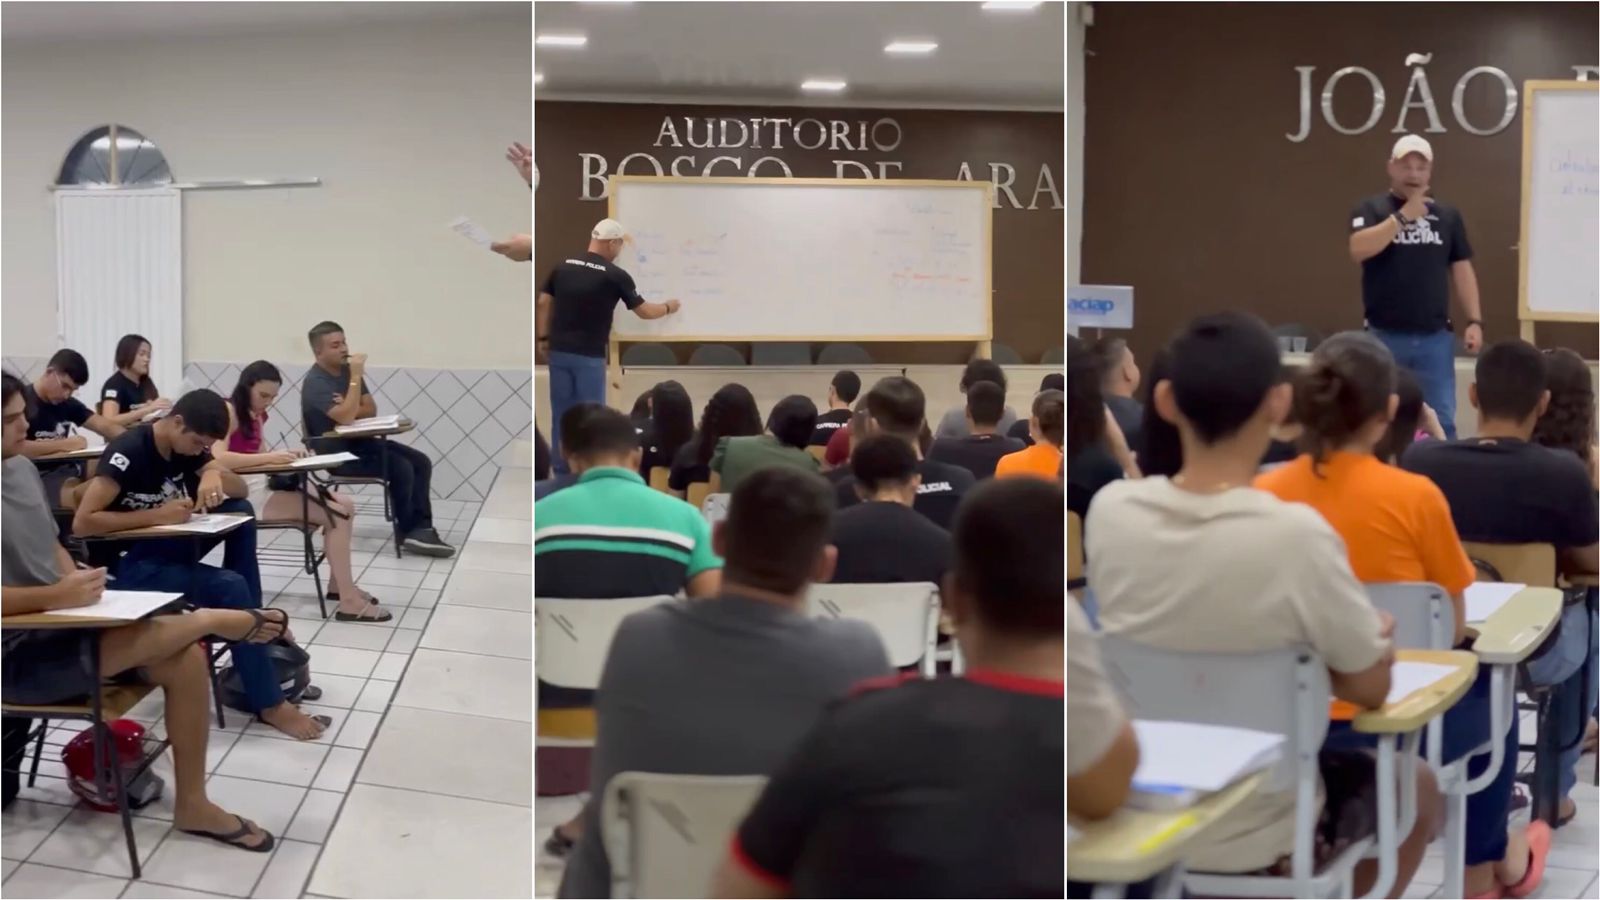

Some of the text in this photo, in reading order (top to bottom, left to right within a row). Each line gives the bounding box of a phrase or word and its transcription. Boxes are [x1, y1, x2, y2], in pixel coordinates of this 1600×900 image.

[1286, 52, 1519, 142] JOÃO
[653, 116, 902, 152] AUDITORIO
[1392, 230, 1443, 245] OLICIAL
